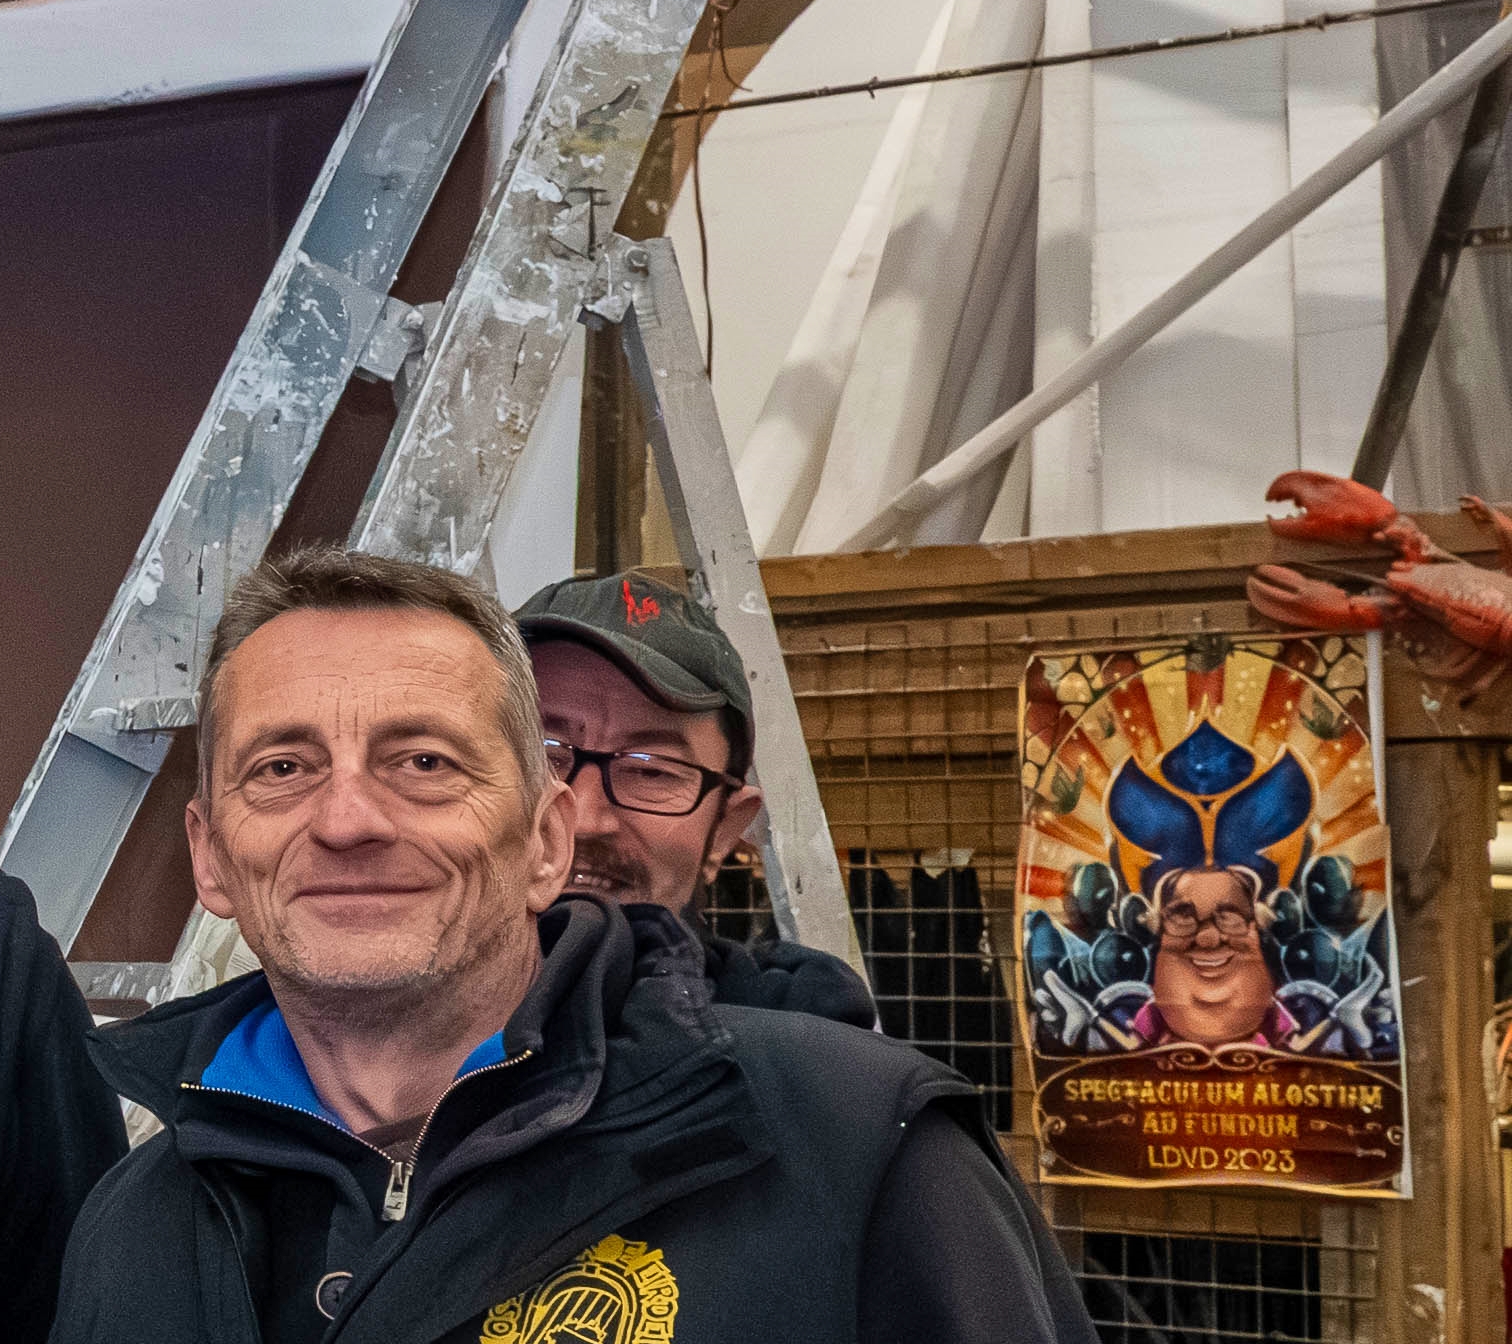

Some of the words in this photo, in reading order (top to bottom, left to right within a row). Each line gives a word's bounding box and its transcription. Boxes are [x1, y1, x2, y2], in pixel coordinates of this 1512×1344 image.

[1143, 1110, 1178, 1135] AD
[1184, 1112, 1298, 1138] FUNDUM
[1148, 1144, 1219, 1170] LDVD
[1223, 1148, 1296, 1173] 2023
